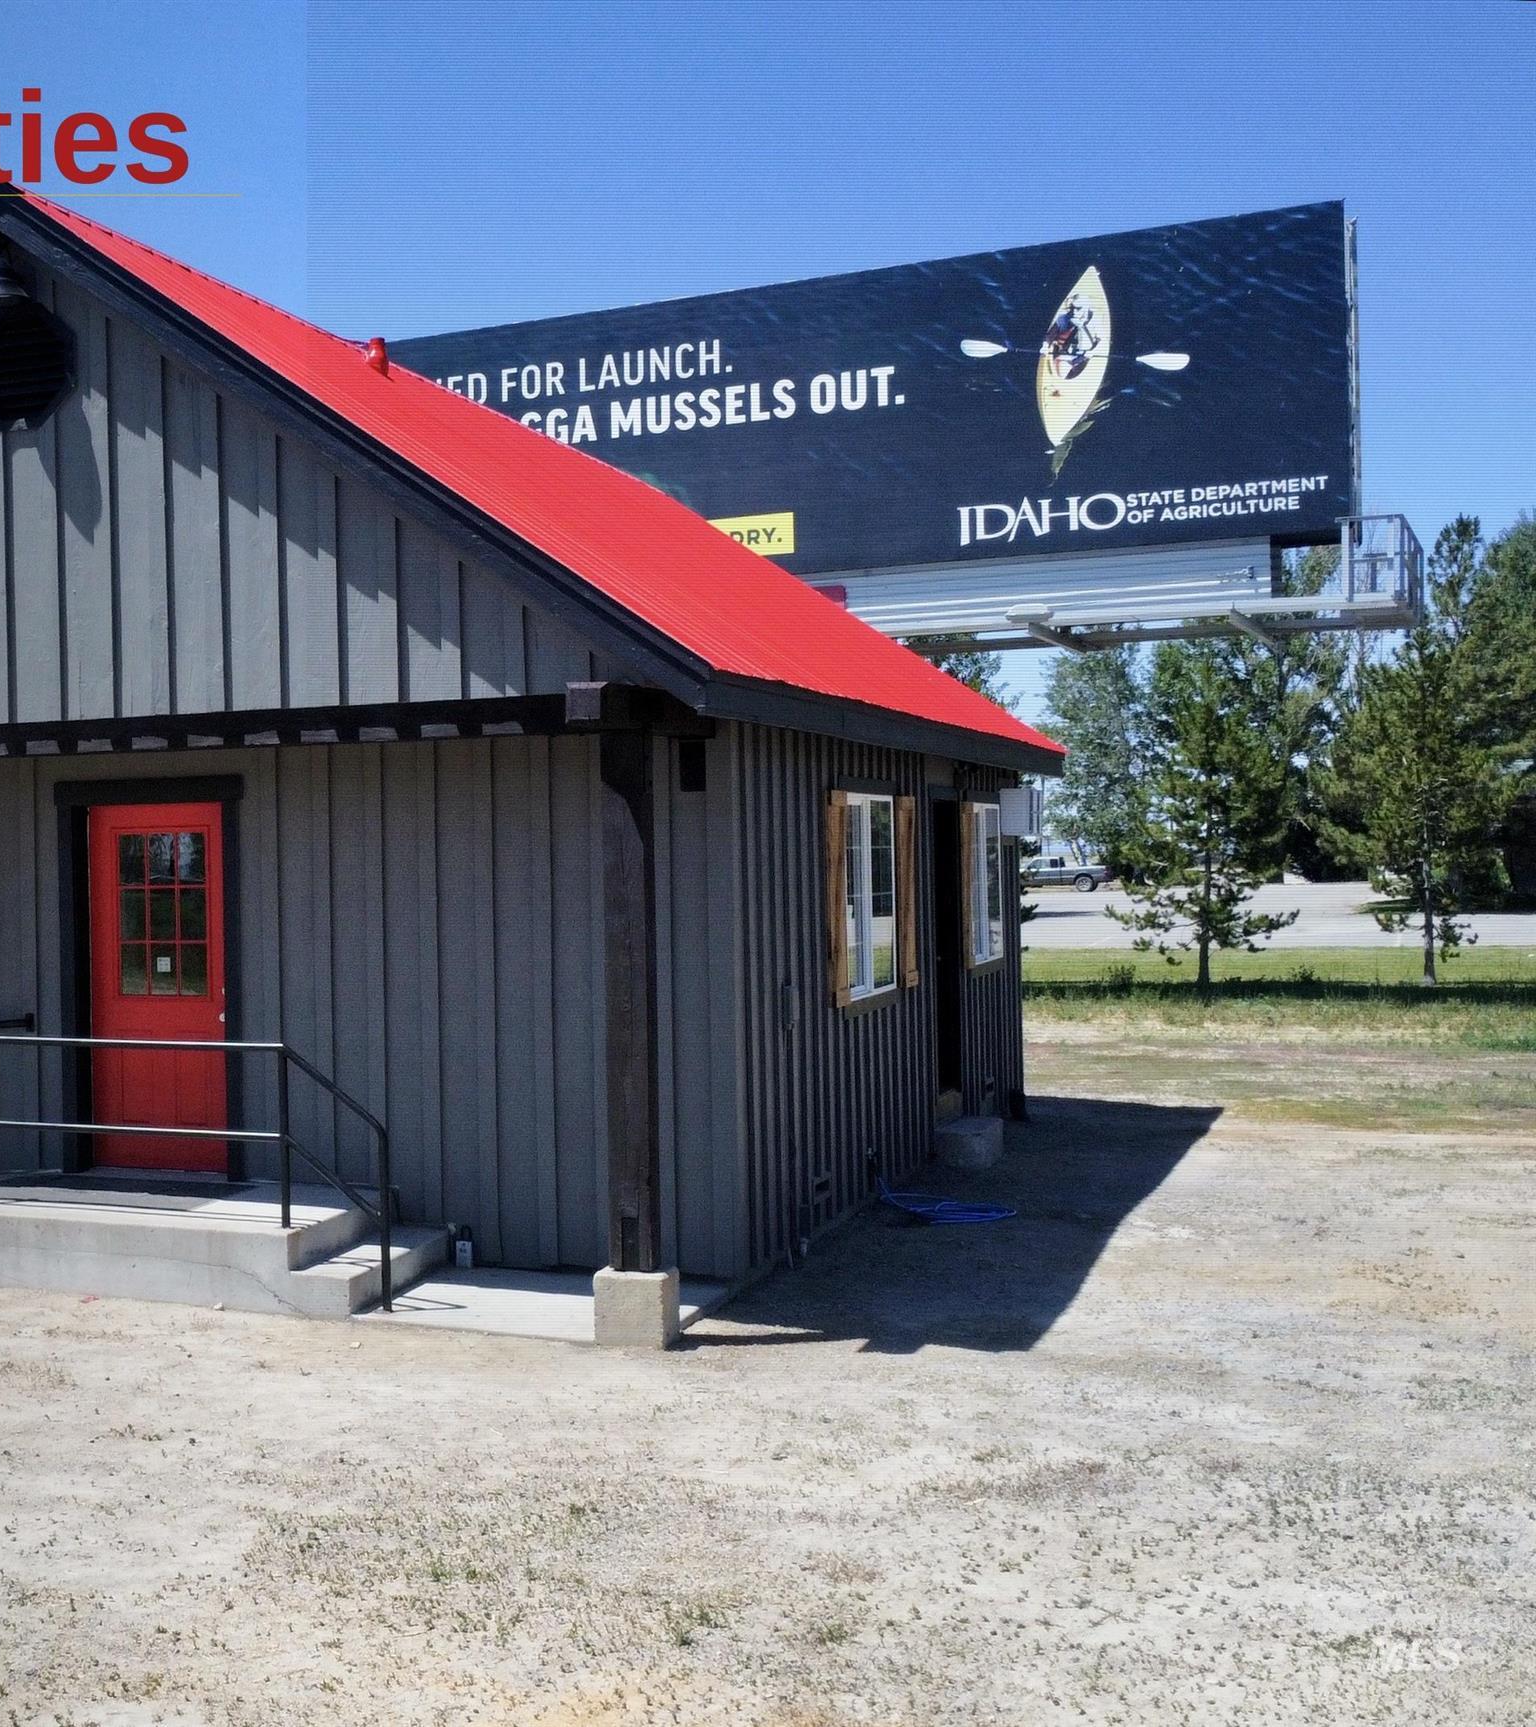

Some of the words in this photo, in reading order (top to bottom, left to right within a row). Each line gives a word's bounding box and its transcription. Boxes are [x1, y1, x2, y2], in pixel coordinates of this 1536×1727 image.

[501, 361, 566, 403] FOR
[579, 338, 733, 392] LAUNCH.
[610, 378, 796, 439] MUSSELS
[809, 365, 905, 414] OUT.
[1126, 489, 1185, 508] STATE
[1191, 475, 1329, 503] DEPARTMENT
[1127, 508, 1154, 525] OF
[1159, 496, 1300, 522] AGRICULTURE
[957, 493, 1126, 546] IDAHO
